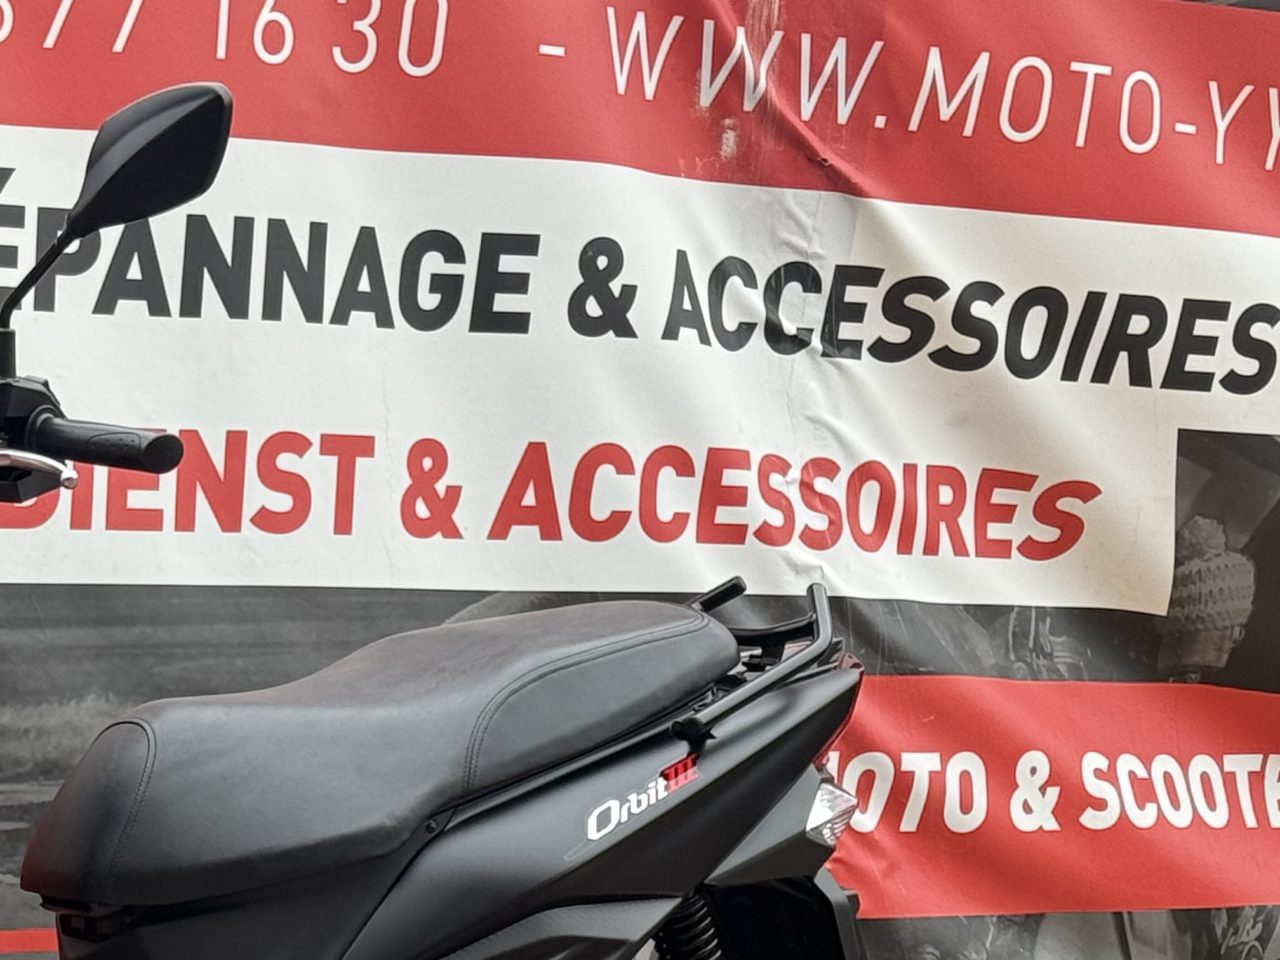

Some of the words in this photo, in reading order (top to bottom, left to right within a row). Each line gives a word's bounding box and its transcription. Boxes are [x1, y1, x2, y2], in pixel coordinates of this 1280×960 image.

[331, 0, 449, 78] 30
[566, 235, 639, 342] &
[660, 248, 1280, 397] ACCESSOIRES
[399, 437, 465, 541] &
[486, 440, 1104, 563] ACCESSOIRES
[822, 750, 989, 834] OTO
[1008, 749, 1062, 833] &
